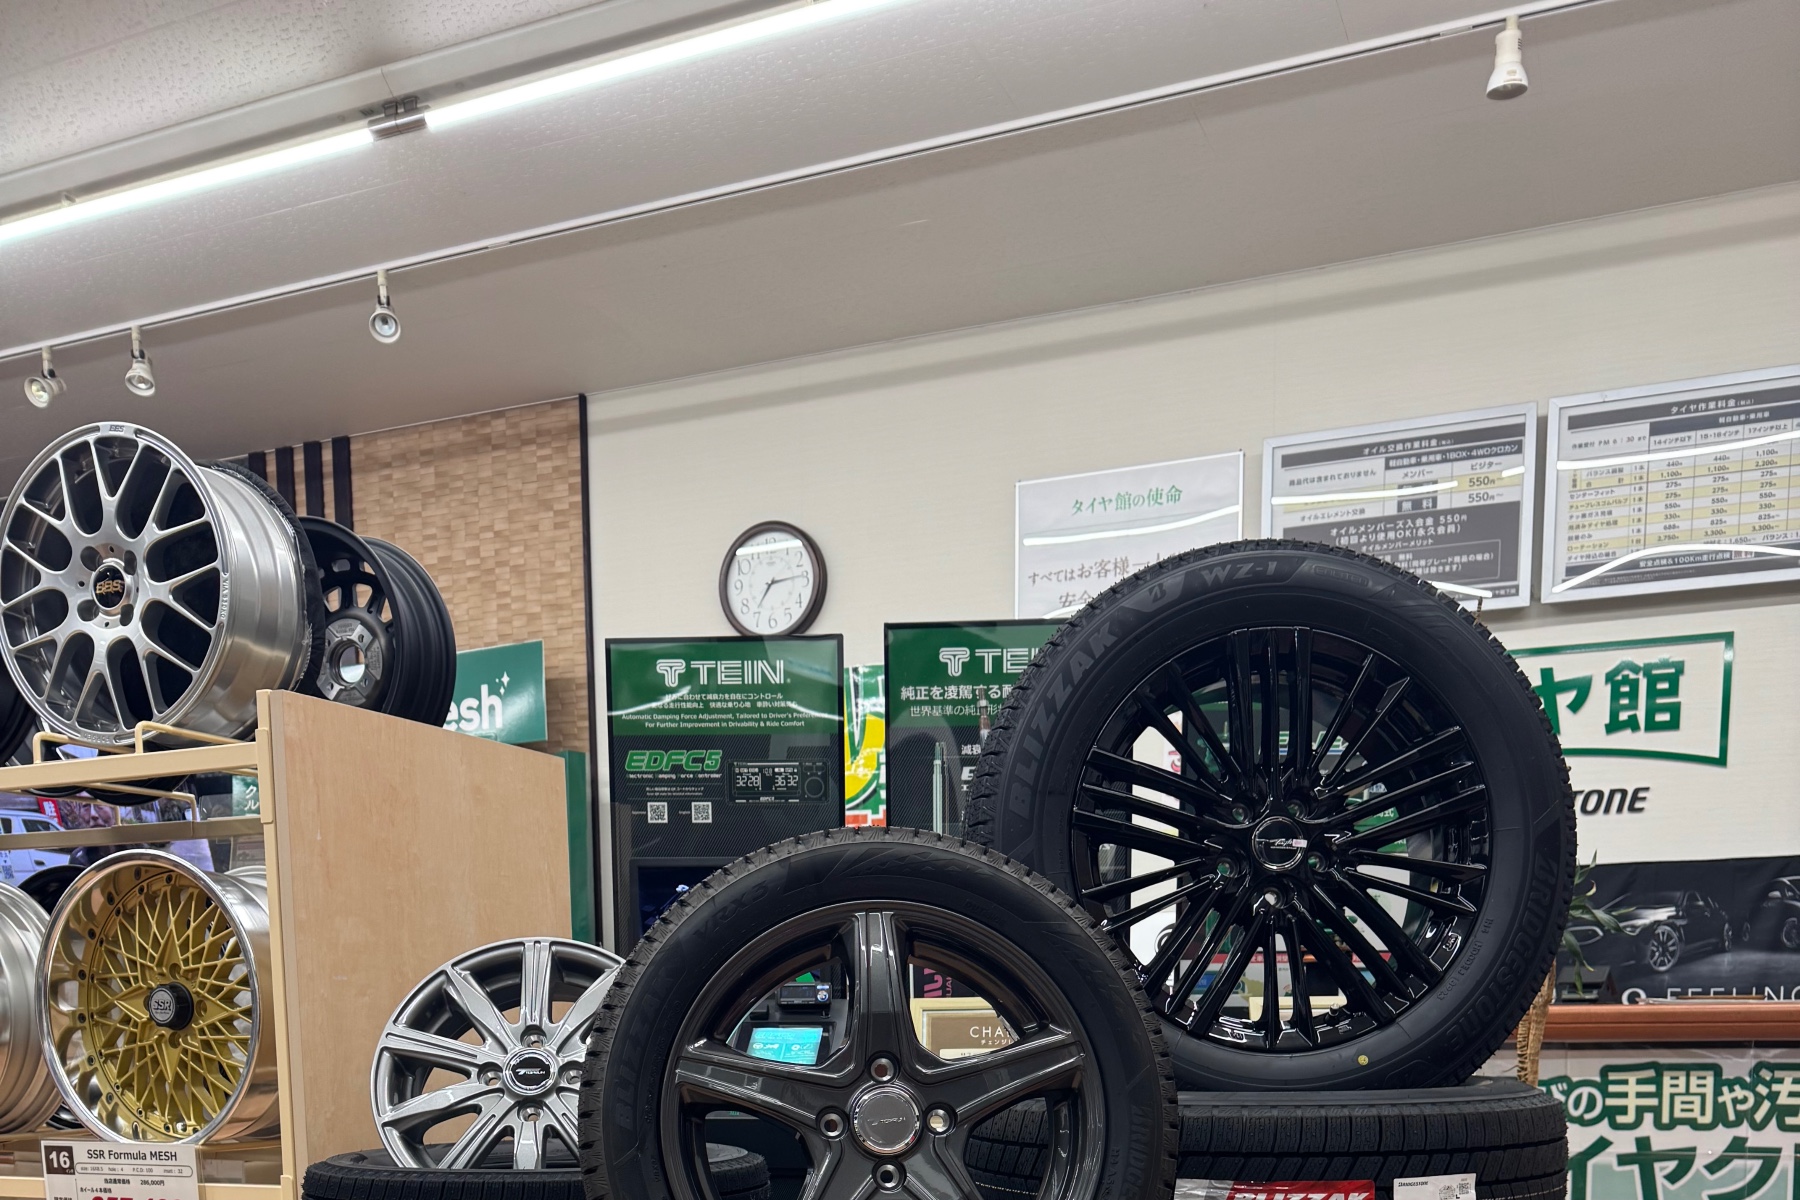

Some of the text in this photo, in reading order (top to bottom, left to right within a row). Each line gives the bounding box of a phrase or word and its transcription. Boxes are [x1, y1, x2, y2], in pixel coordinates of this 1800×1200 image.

[1671, 399, 1736, 414] タイヤ作業料金
[1362, 438, 1438, 455] オイル交換作業料金
[1402, 469, 1433, 479] メンバー
[1470, 461, 1503, 470] ビジター
[1072, 485, 1183, 515] タイヤ館の使命
[737, 559, 752, 576] 10
[1201, 560, 1278, 587] WZ-1
[96, 579, 126, 595] BBS
[734, 579, 744, 595] 9
[795, 593, 803, 608] 4
[753, 611, 761, 628] 7
[690, 659, 784, 685] TEIN
[1531, 655, 1685, 736] ヤ館
[653, 713, 680, 721] Damping
[728, 720, 759, 728] Drivability
[1008, 622, 1121, 820] BLIZZAK
[625, 750, 723, 771] EDFC5
[1446, 853, 1559, 1051] BRIDGESTONE
[153, 1000, 172, 1011] SSR
[49, 1149, 177, 1168] 16 SSR Formula MESH
